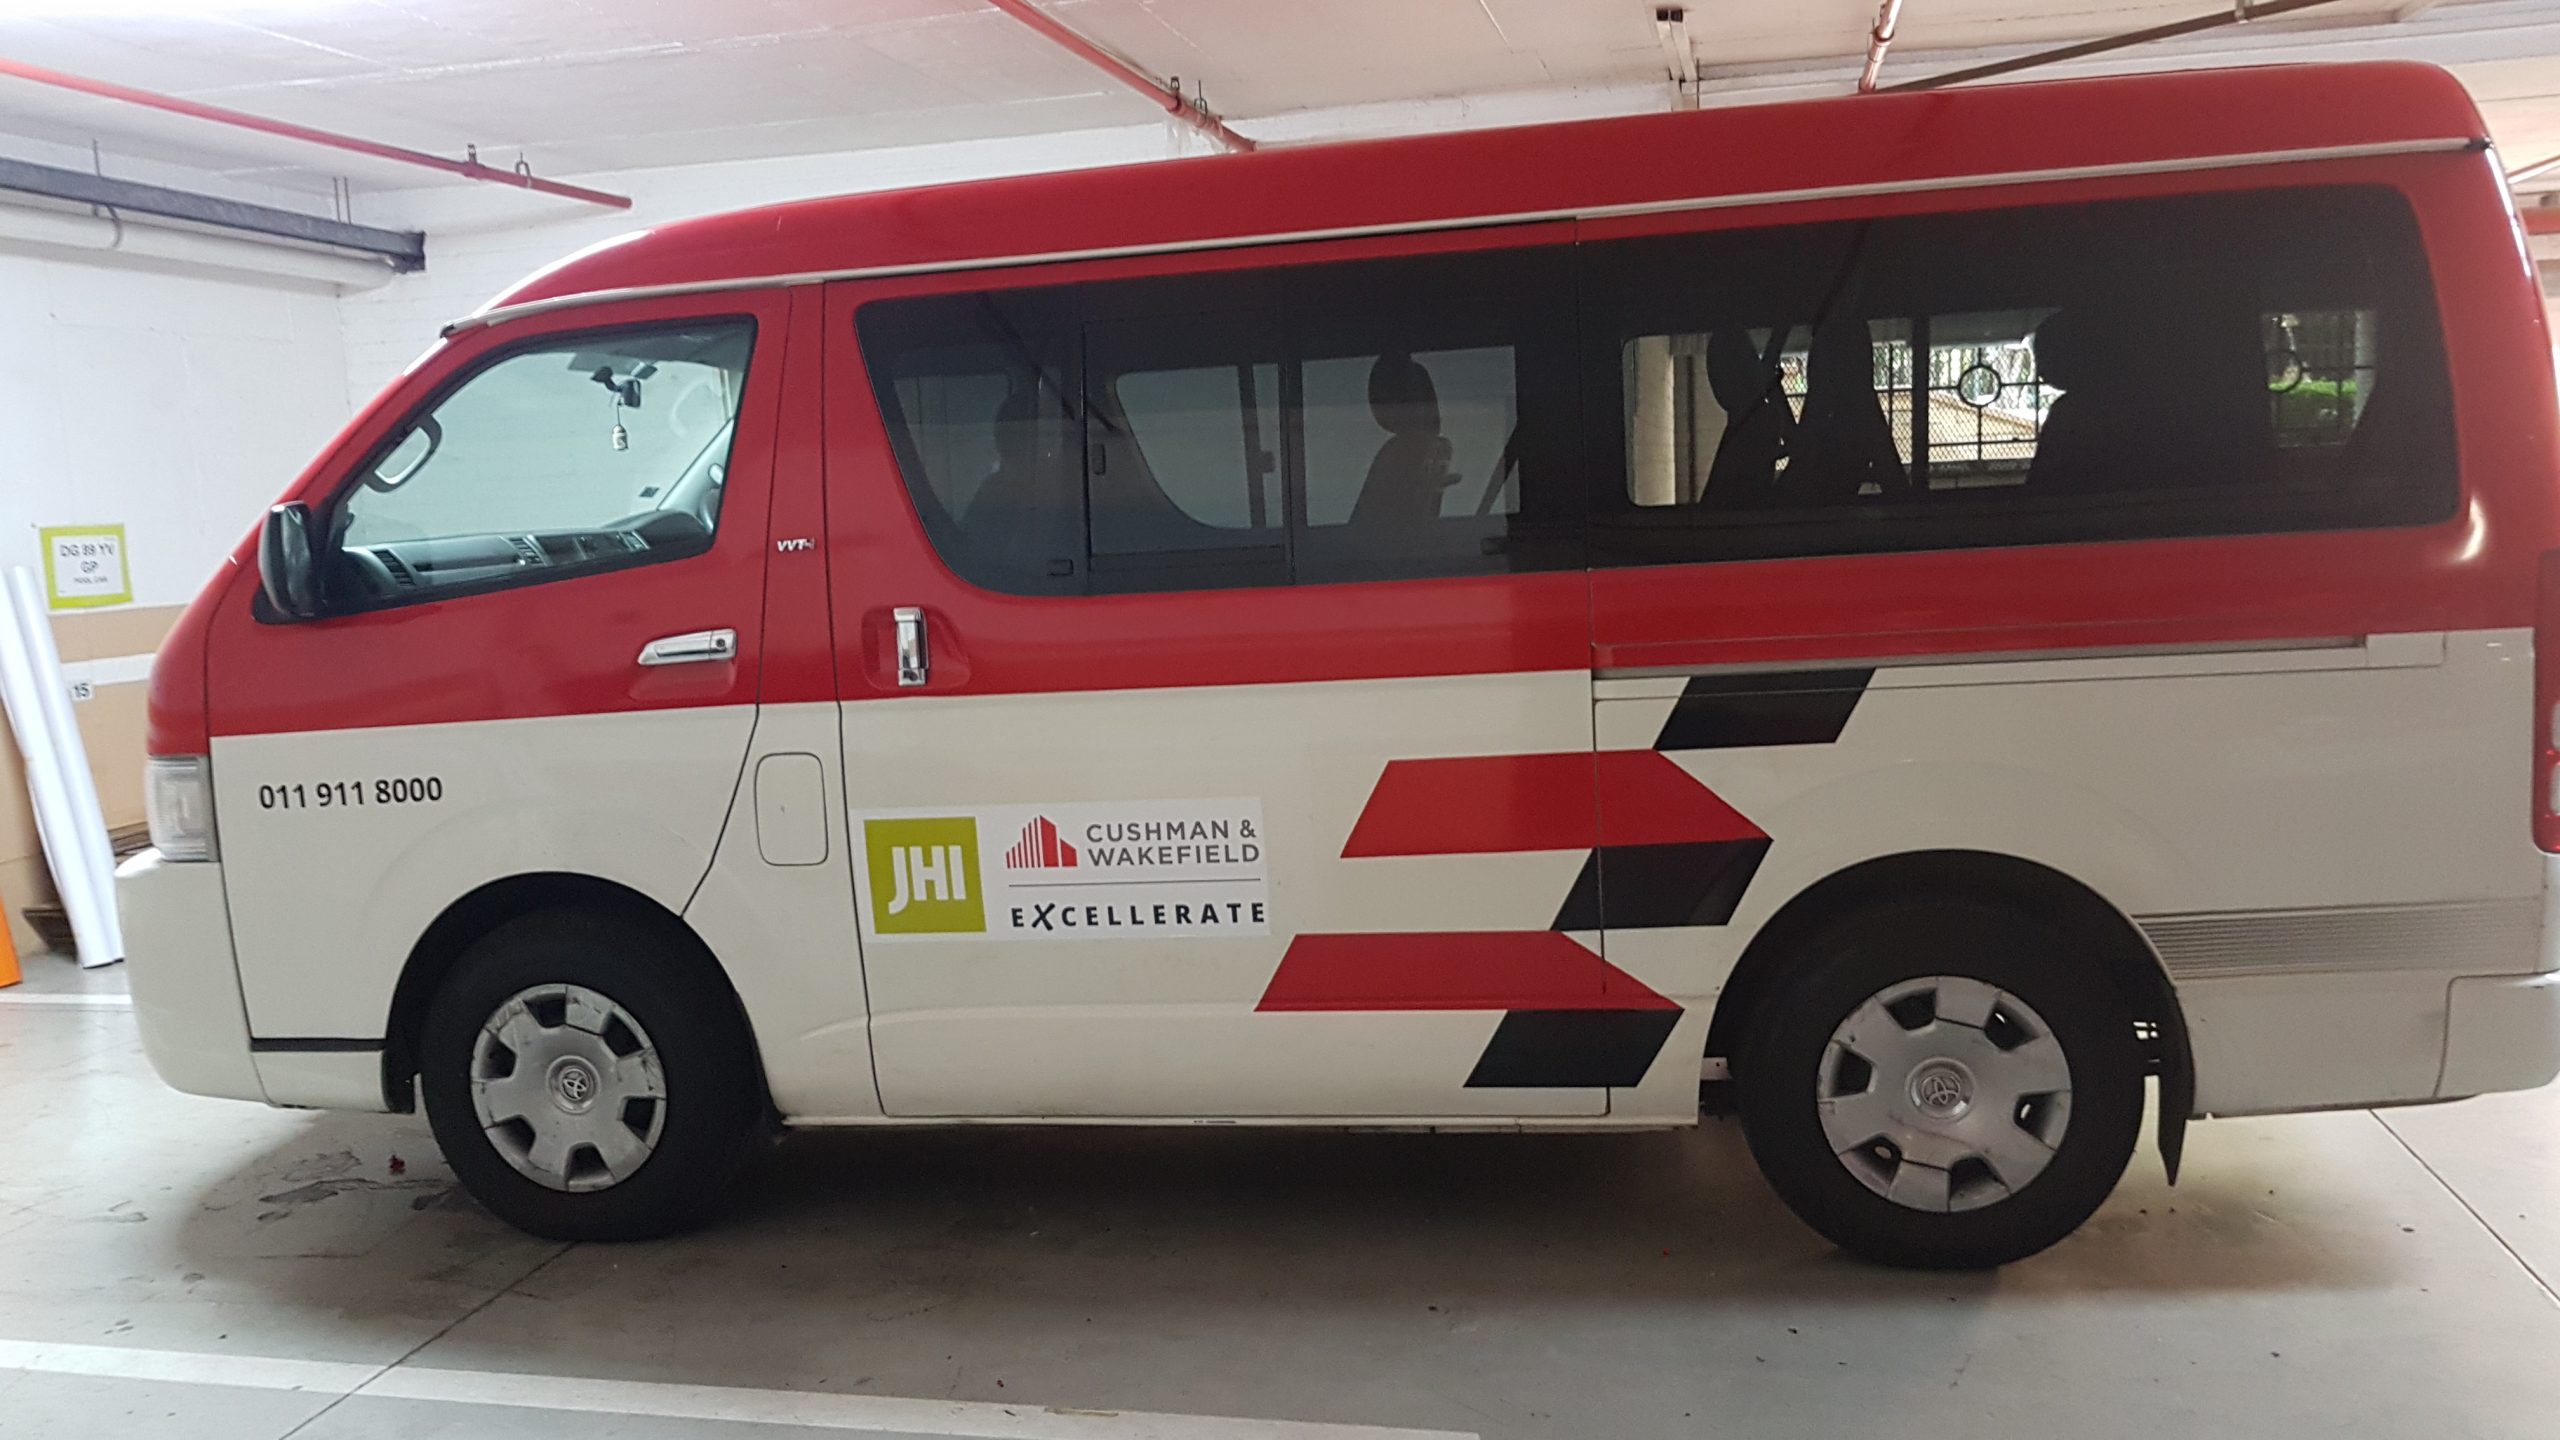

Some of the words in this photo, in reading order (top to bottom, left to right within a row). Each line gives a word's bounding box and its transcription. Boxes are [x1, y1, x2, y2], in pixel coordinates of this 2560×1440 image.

[74, 682, 90, 699] 15
[259, 783, 306, 809] 011
[316, 781, 364, 807] 911
[374, 776, 443, 804] 8000
[1086, 819, 1230, 844] CUSHMAN
[1239, 818, 1258, 839] &
[1087, 843, 1261, 867] WAKEFIELD
[887, 844, 967, 916] JHI
[1010, 901, 1266, 931] EXCELLERATE
